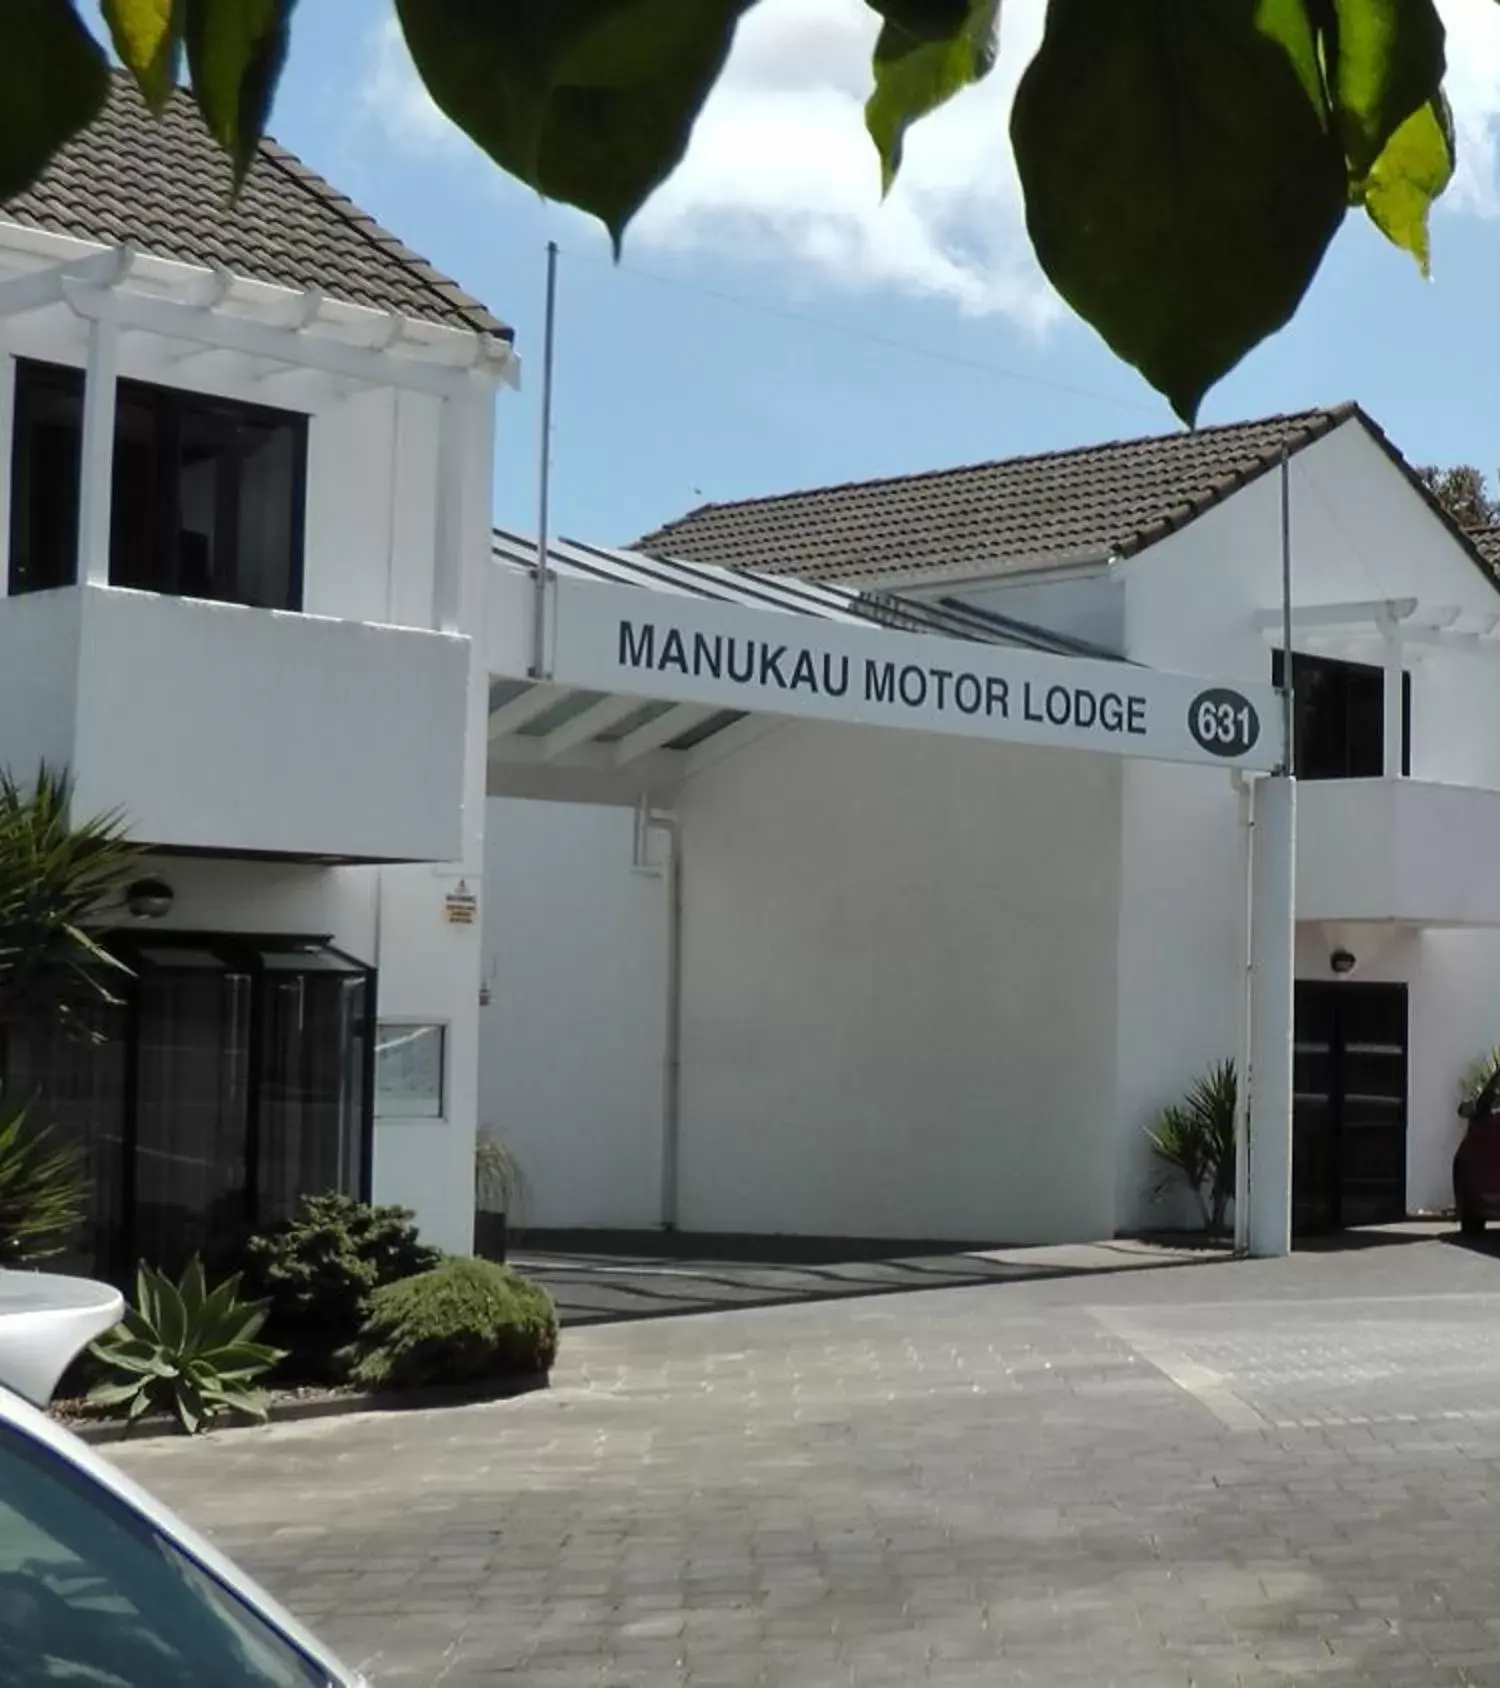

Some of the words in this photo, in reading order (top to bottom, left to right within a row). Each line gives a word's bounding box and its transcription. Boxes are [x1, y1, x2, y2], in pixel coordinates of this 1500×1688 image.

[618, 620, 849, 697] MANUKAU
[864, 659, 1009, 718] MOTOR
[1023, 682, 1147, 735] LODGE
[1197, 702, 1250, 745] 631
